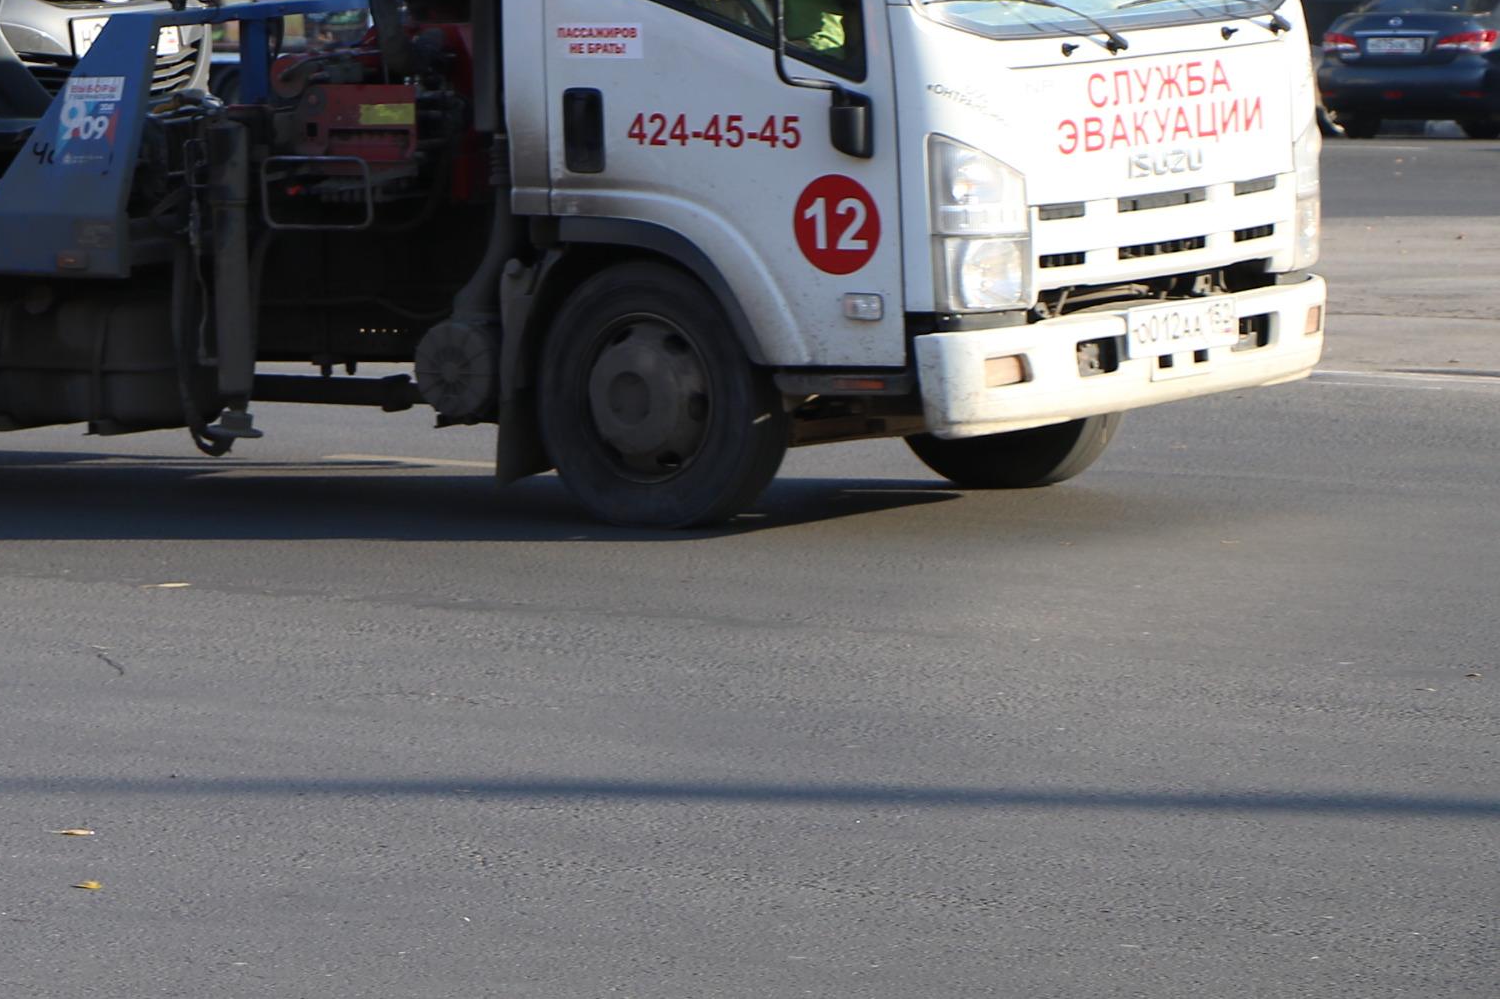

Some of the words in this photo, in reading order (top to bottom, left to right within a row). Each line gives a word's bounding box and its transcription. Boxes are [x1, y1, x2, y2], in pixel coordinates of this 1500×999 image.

[557, 26, 638, 40] ПАССАЖИРОВ
[569, 42, 586, 54] НЕ
[588, 42, 626, 55] БРАТЬ!
[1087, 59, 1233, 108] СЛУЖБА
[627, 112, 801, 149] 424-45-45
[1057, 96, 1264, 155] ЭВАКУАЦИИ
[1128, 148, 1204, 179] ISUZU
[803, 196, 869, 250] 12
